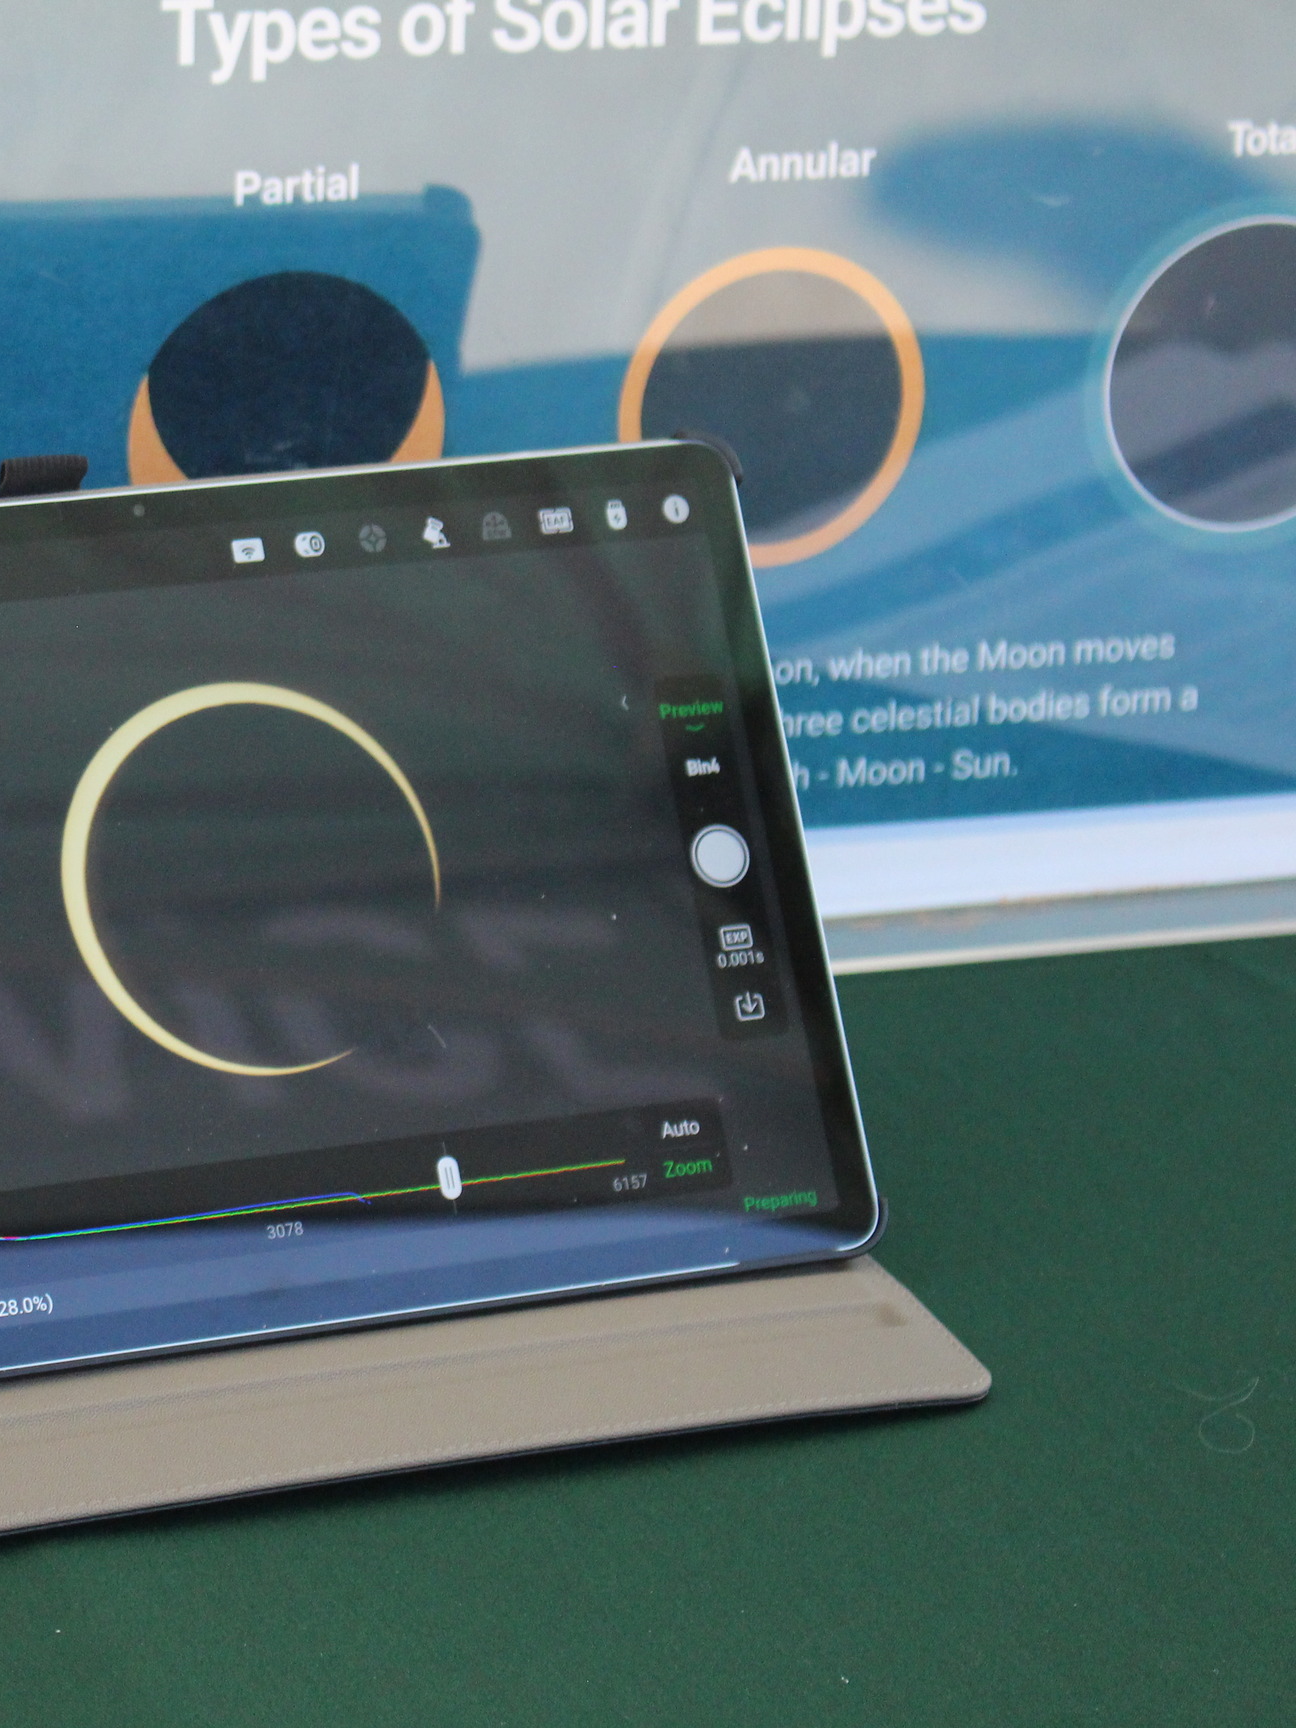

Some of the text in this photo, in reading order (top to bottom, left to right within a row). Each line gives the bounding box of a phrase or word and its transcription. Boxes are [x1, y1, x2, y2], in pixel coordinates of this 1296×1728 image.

[161, 0, 988, 84] Types of Solar Eclipses
[730, 142, 877, 184] Annular
[234, 165, 360, 208] Partial
[773, 631, 1177, 688] on, when the Moon moves
[657, 701, 725, 720] Preview
[779, 683, 1200, 739] hree celestial bodies form a
[685, 757, 721, 777] Bin4
[834, 755, 926, 791] Moon
[950, 747, 1020, 783] Sun.
[715, 950, 766, 969] 0.001s
[661, 1118, 701, 1140] Auto
[662, 1157, 714, 1180] Zoom
[612, 1173, 649, 1194] 6157
[742, 1186, 820, 1214] Preparing
[265, 1220, 305, 1241] 3078
